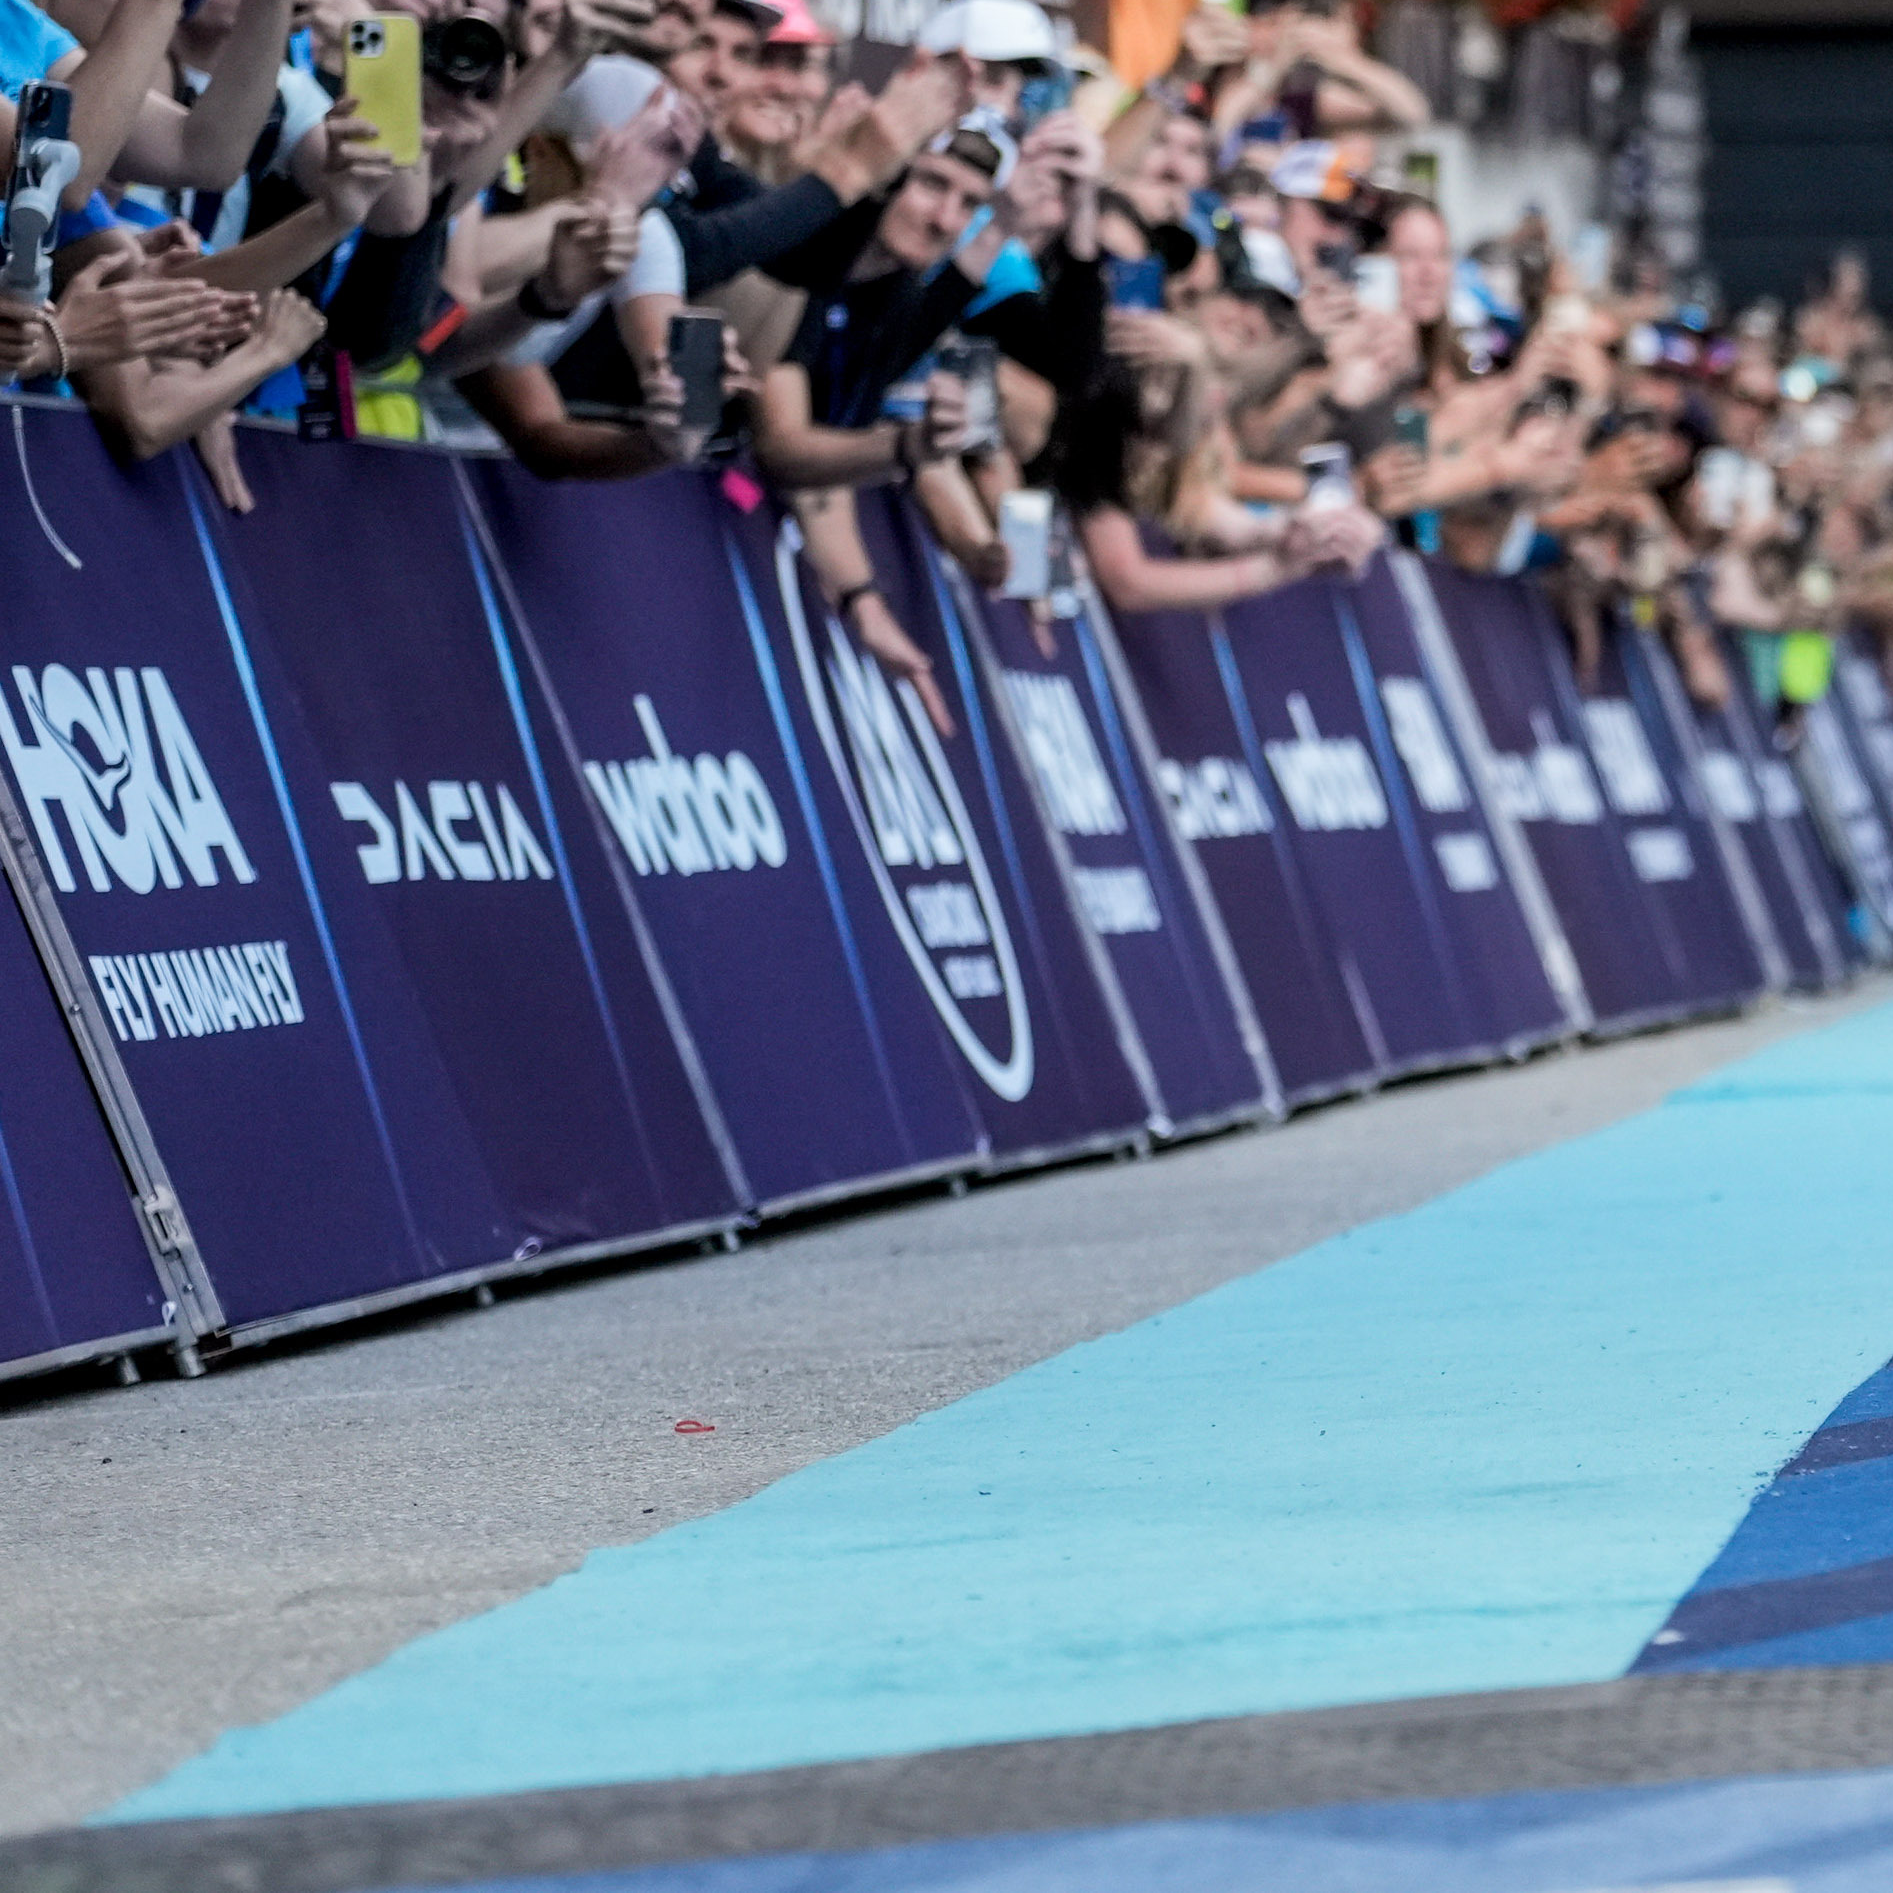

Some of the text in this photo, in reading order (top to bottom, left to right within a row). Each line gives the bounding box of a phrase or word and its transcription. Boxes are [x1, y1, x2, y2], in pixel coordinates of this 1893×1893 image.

[0, 663, 258, 895] HOKA
[330, 778, 556, 884] DACIA
[583, 694, 787, 877] wahoo
[88, 939, 305, 1041] FLY HUMAN FLY
